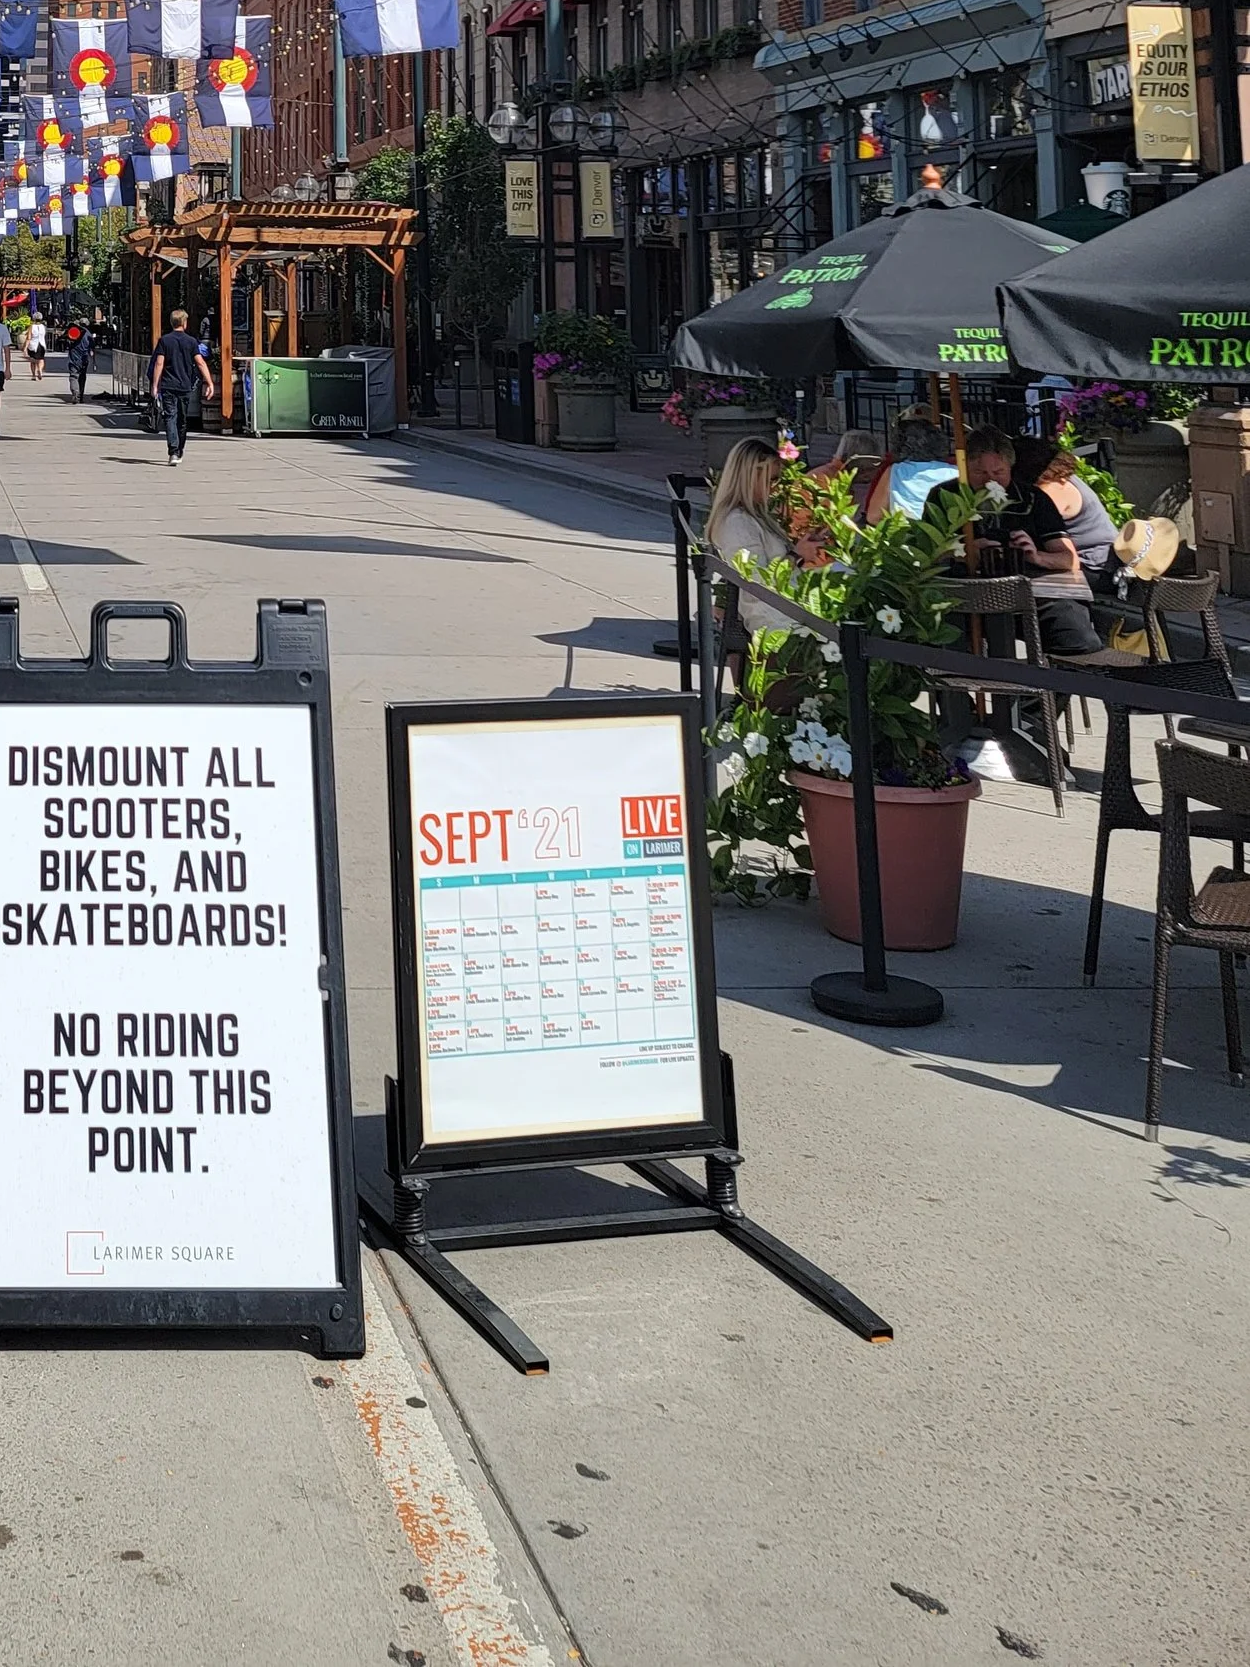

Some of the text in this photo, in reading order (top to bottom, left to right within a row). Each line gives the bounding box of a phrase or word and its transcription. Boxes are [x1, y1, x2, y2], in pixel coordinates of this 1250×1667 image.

[1137, 44, 1188, 59] EQUITY
[1138, 62, 1188, 76] IS OUR
[1091, 64, 1131, 105] STAR
[1138, 82, 1190, 98] ETHOS
[1160, 134, 1191, 143] Denver
[510, 177, 534, 186] LOVE
[511, 189, 534, 199] THIS
[512, 202, 533, 211] CITY
[8, 745, 276, 788] DISMOUNT ALL
[43, 797, 242, 845] SCOOTERS,
[623, 797, 681, 835] LIVE
[419, 809, 514, 866] SEPT
[626, 841, 681, 855] ON LARIMER
[39, 849, 247, 897] BIKES, AND
[2, 902, 287, 947] SKATEBOARDS!
[53, 1012, 239, 1057] NO RIDING
[23, 1068, 272, 1115] BEYOND THIS
[87, 1126, 210, 1173] POINT.
[93, 1245, 235, 1263] LARIMER SQUARE
